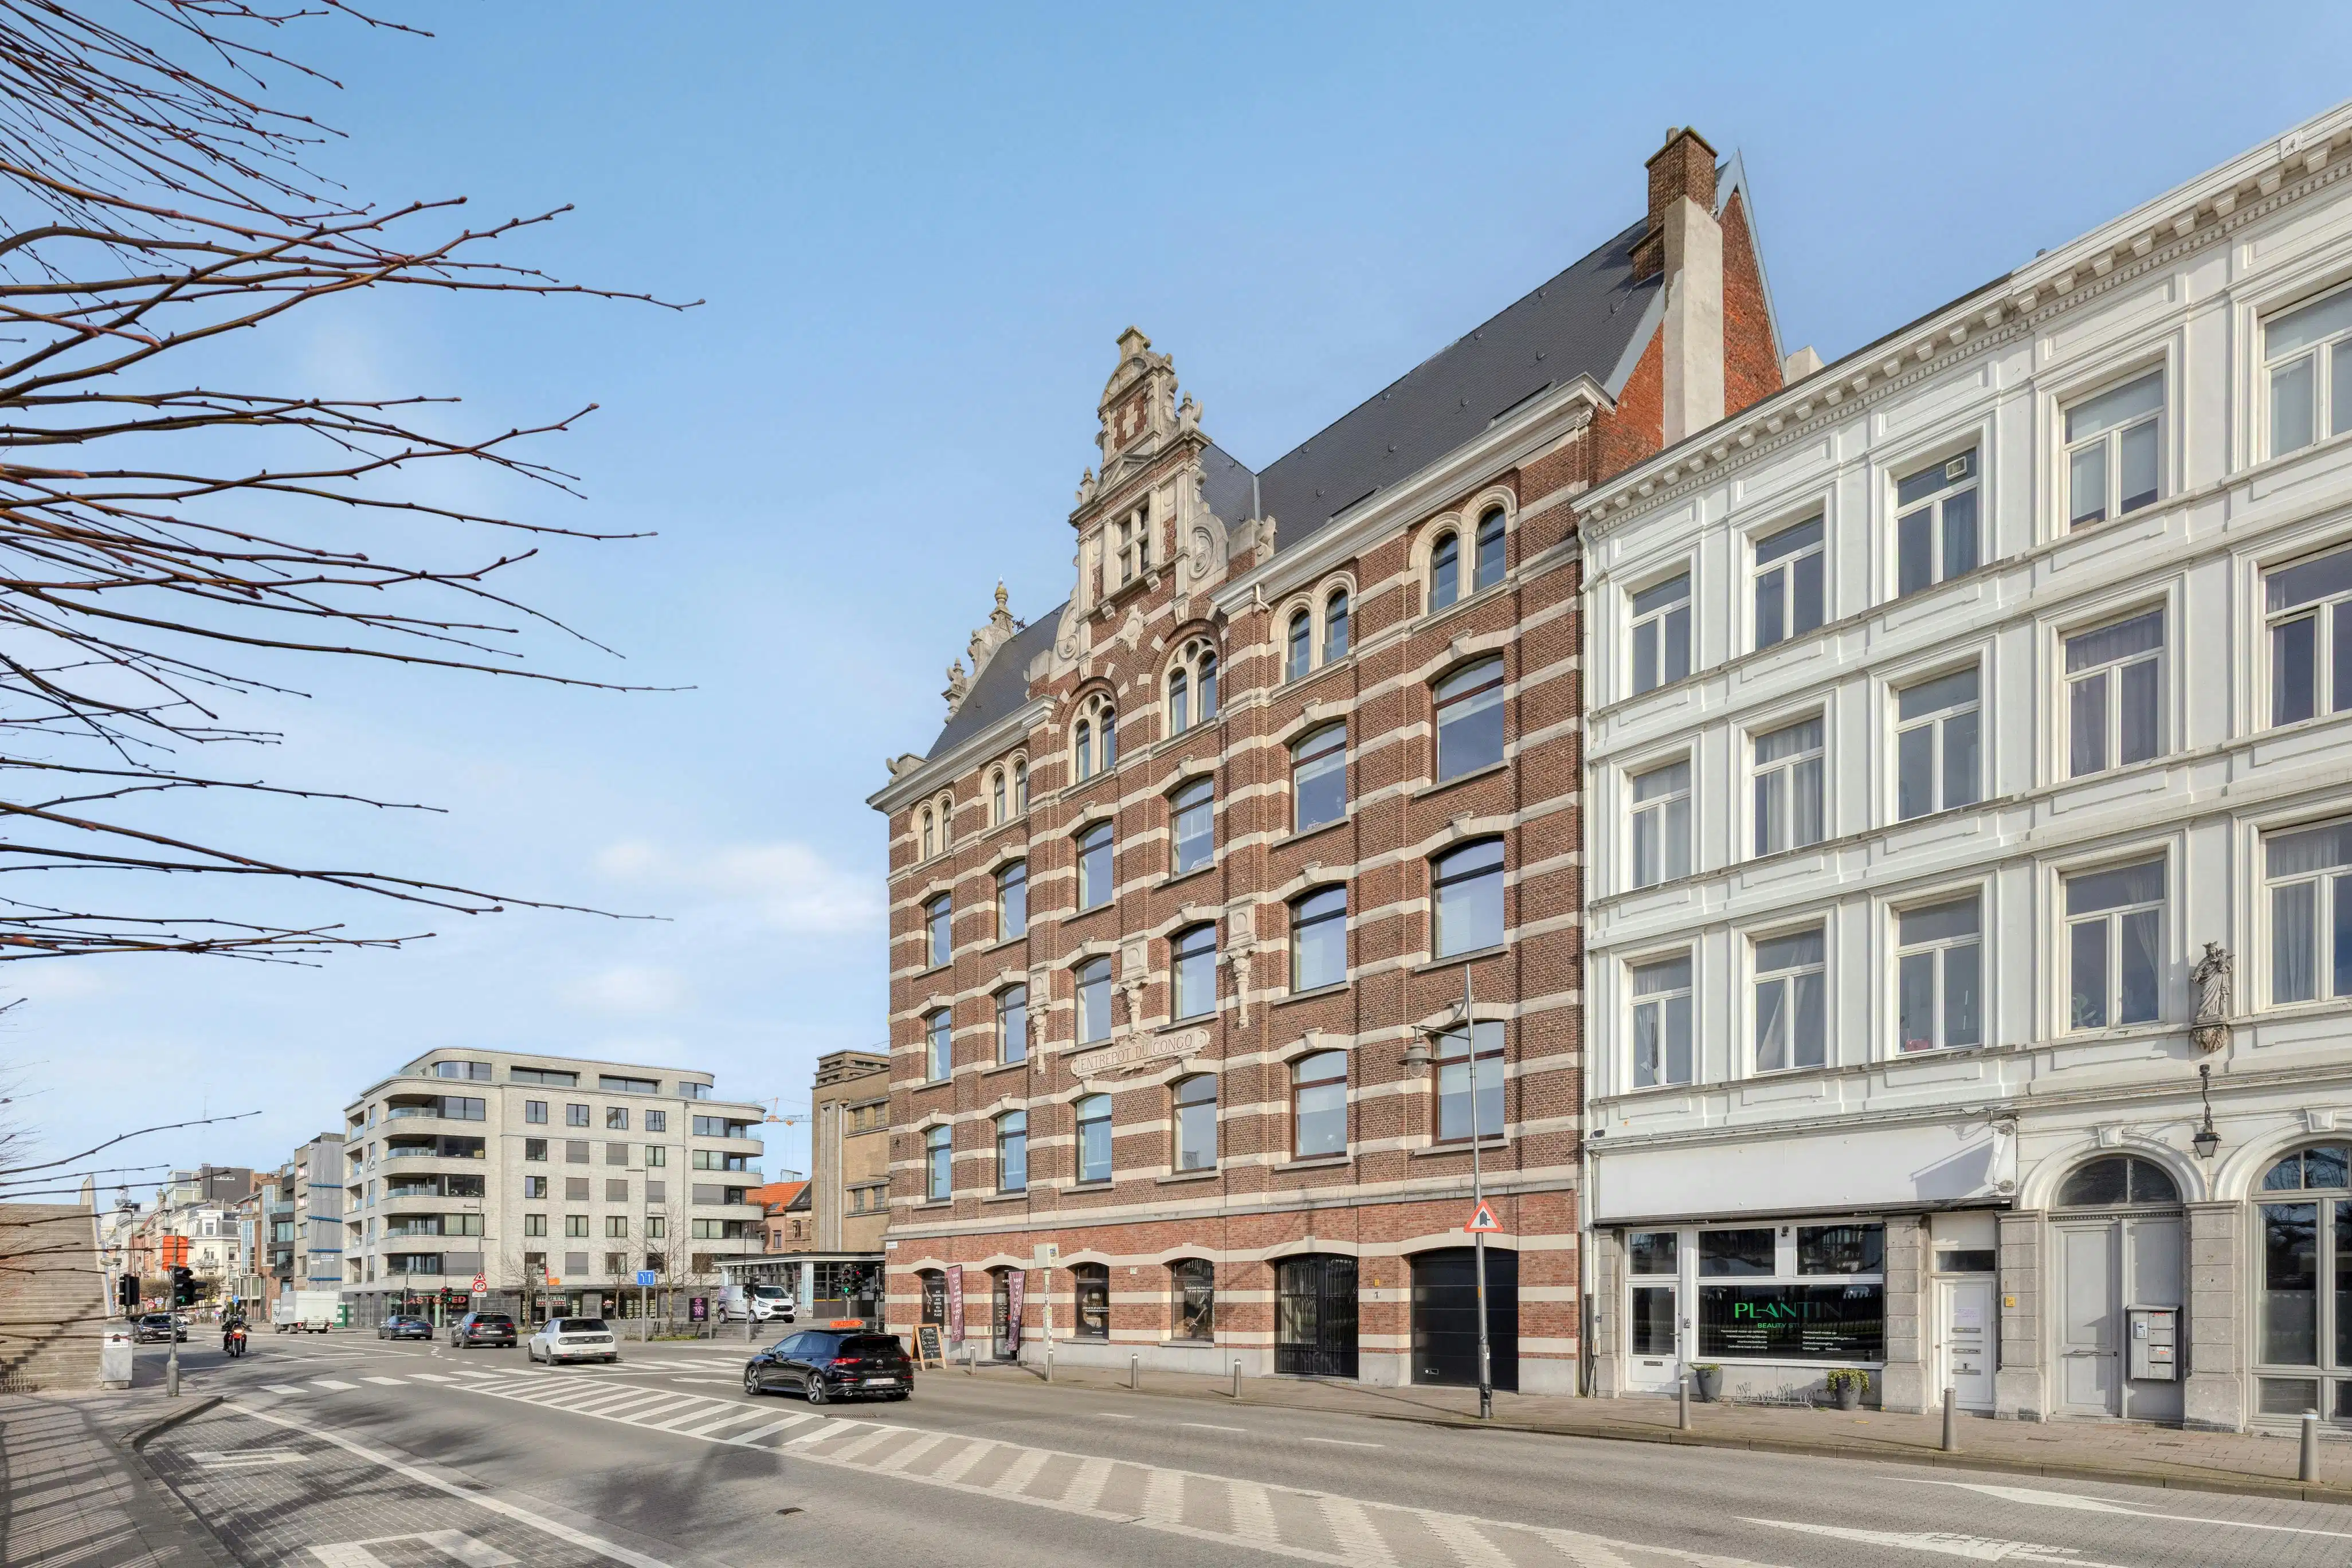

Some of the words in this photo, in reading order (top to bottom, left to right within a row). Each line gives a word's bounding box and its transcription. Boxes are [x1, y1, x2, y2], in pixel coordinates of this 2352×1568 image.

[1081, 1048, 1131, 1071] ENTREPOT
[1135, 1044, 1148, 1058] DU
[1153, 1034, 1193, 1054] CONGO
[1735, 1302, 1841, 1318] PLANTIN
